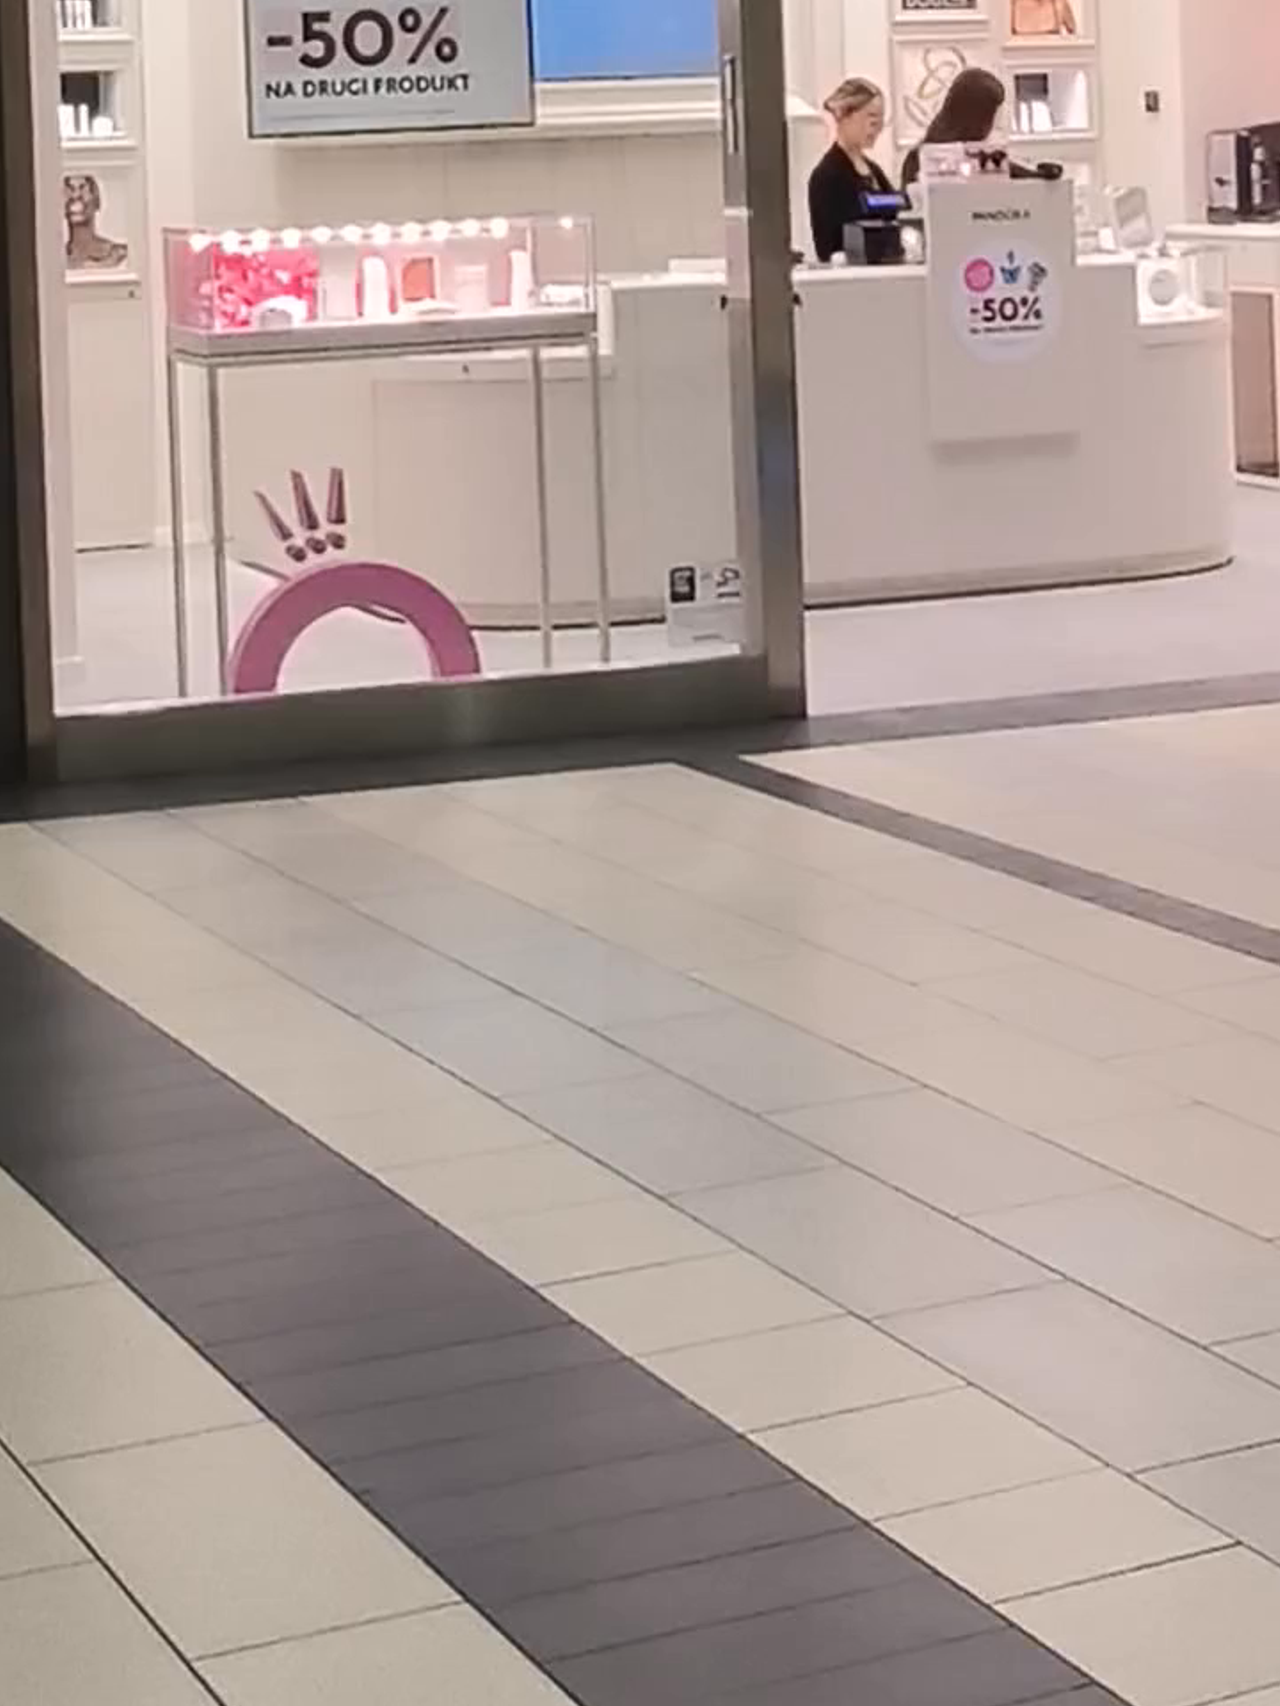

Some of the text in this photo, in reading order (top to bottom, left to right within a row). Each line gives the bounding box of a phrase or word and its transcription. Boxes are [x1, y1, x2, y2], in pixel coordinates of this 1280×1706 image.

[267, 6, 458, 68] -50%
[265, 82, 296, 99] NA
[374, 73, 470, 95] PRODUKT
[969, 296, 1042, 323] -50%
